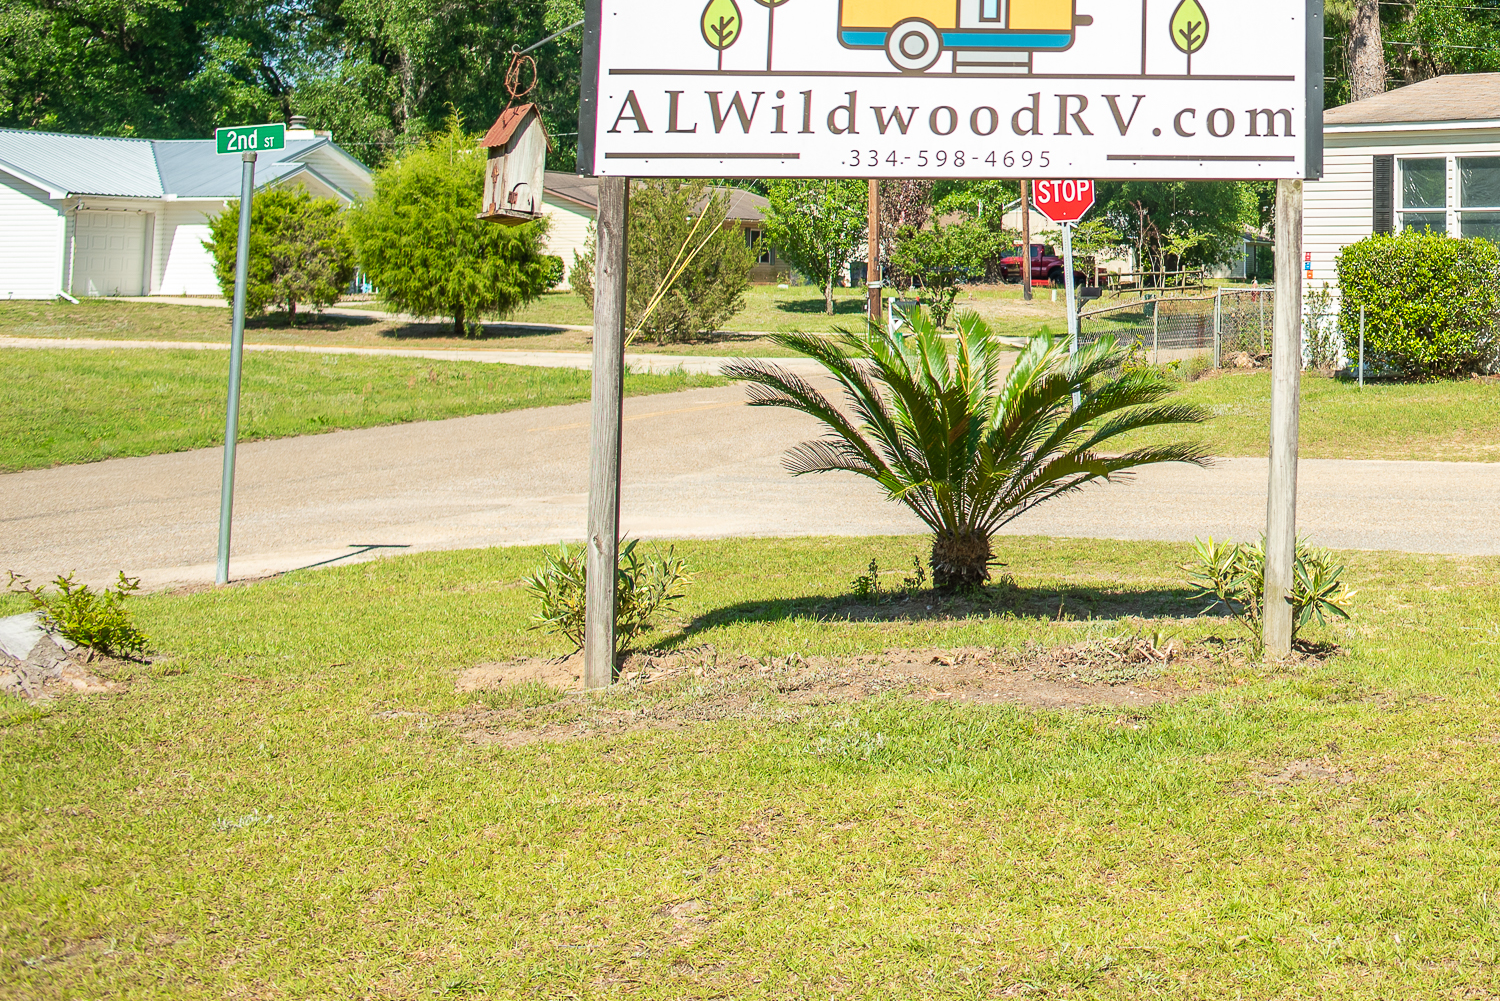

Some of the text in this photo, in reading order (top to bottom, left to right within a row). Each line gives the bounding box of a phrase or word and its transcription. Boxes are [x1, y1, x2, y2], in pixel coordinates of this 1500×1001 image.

[607, 89, 1296, 138] ALWildwoodRV.com
[226, 128, 275, 151] 2nd ST
[849, 149, 1051, 168] 334-598-4695
[1037, 179, 1090, 204] STOP
